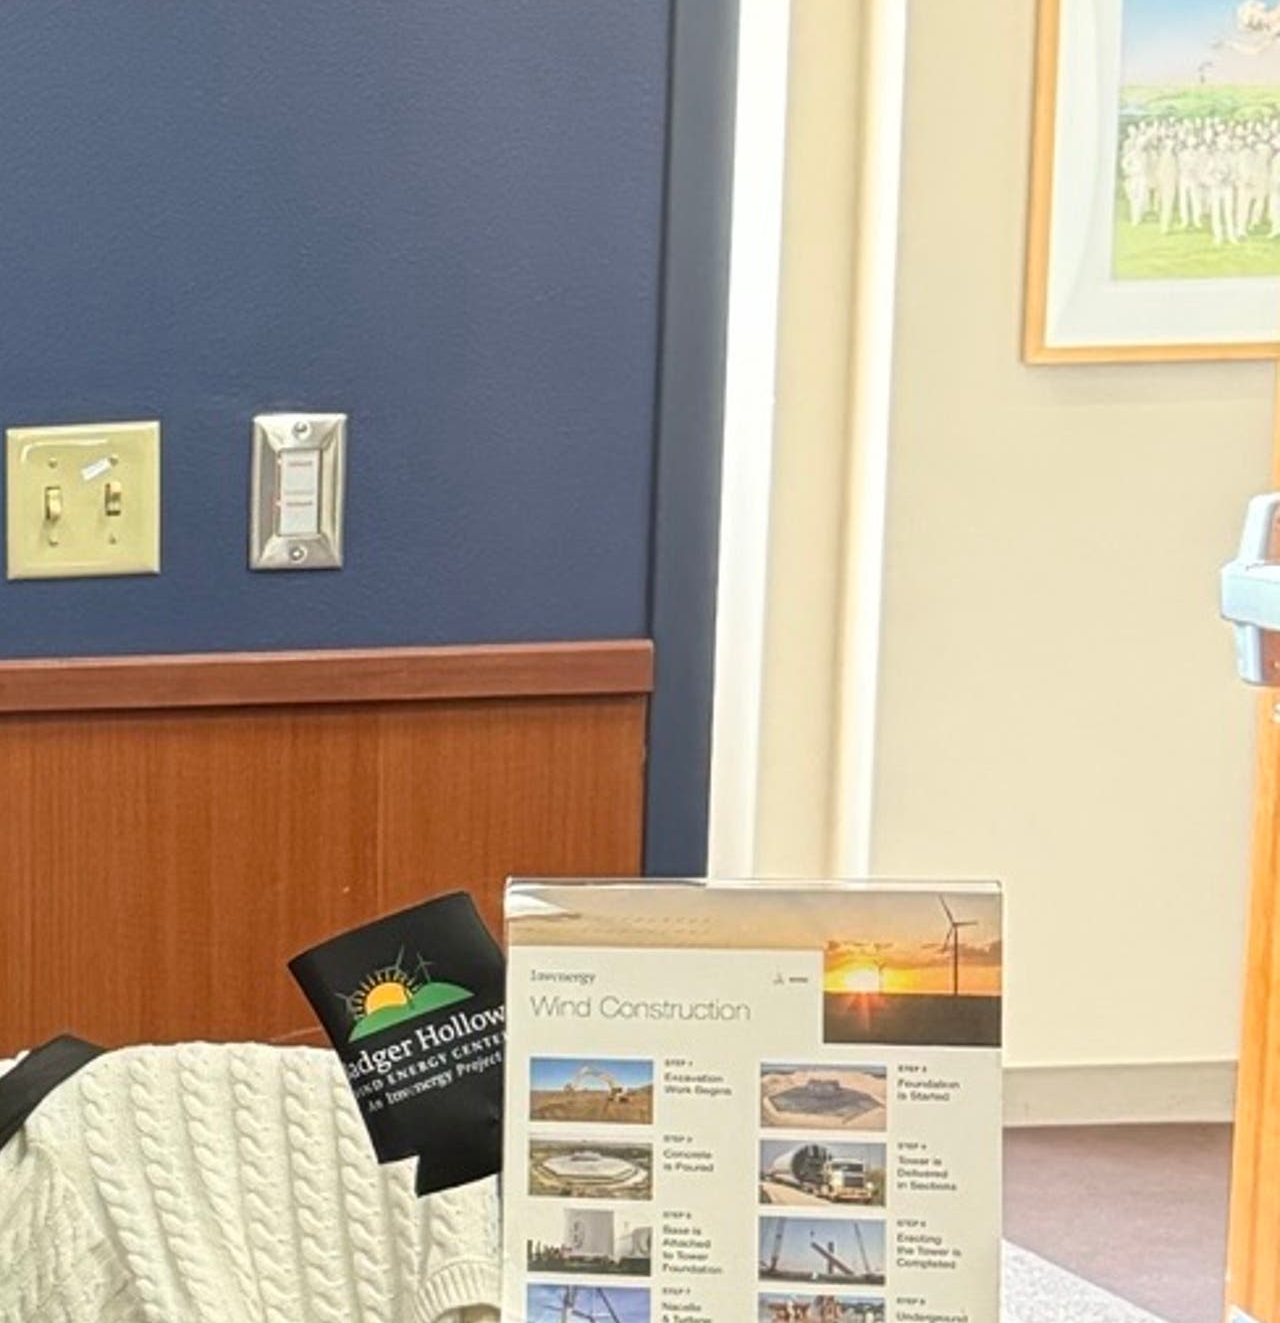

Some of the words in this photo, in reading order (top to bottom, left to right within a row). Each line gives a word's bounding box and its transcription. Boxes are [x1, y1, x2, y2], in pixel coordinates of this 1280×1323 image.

[530, 995, 591, 1018] Wind
[599, 994, 752, 1021] Construction
[348, 1038, 413, 1079] adger
[414, 1005, 505, 1051] Hollow
[386, 1052, 449, 1084] ENERGY
[456, 1051, 503, 1076] Project
